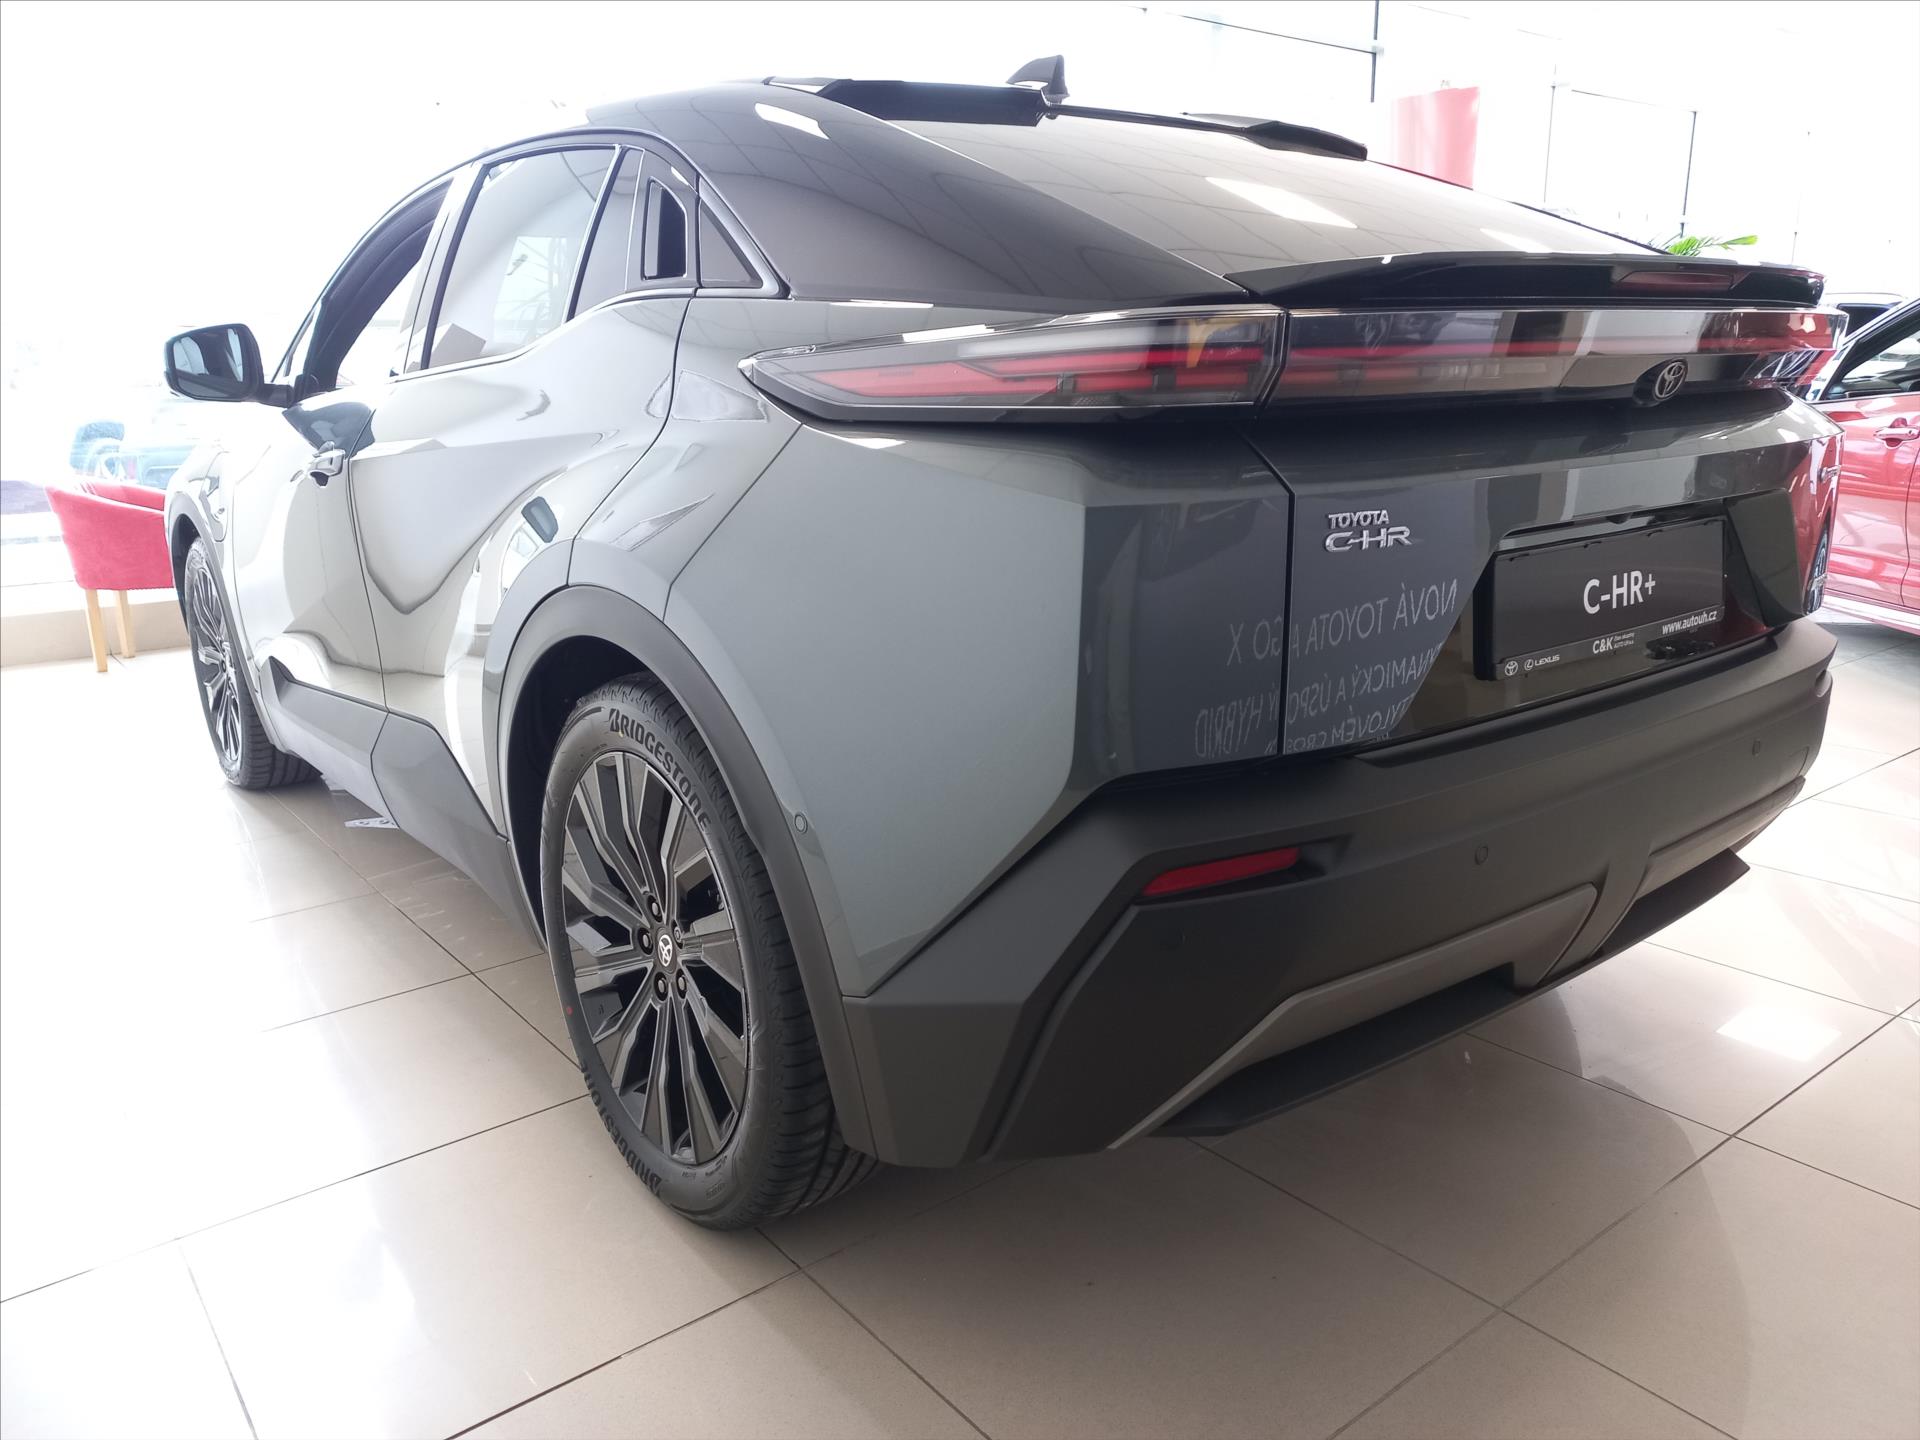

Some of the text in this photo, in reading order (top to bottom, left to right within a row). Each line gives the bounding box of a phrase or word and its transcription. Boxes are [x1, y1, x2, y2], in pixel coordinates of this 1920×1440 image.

[1328, 509, 1389, 529] TOYOTA
[1325, 526, 1412, 552] C-HR
[1584, 570, 1656, 615] C-HR+
[1662, 610, 1718, 635] www.autouh.cz
[1592, 636, 1614, 654] C&K
[1534, 654, 1561, 668] LEXUS
[608, 708, 712, 830] BRIDGESTONE
